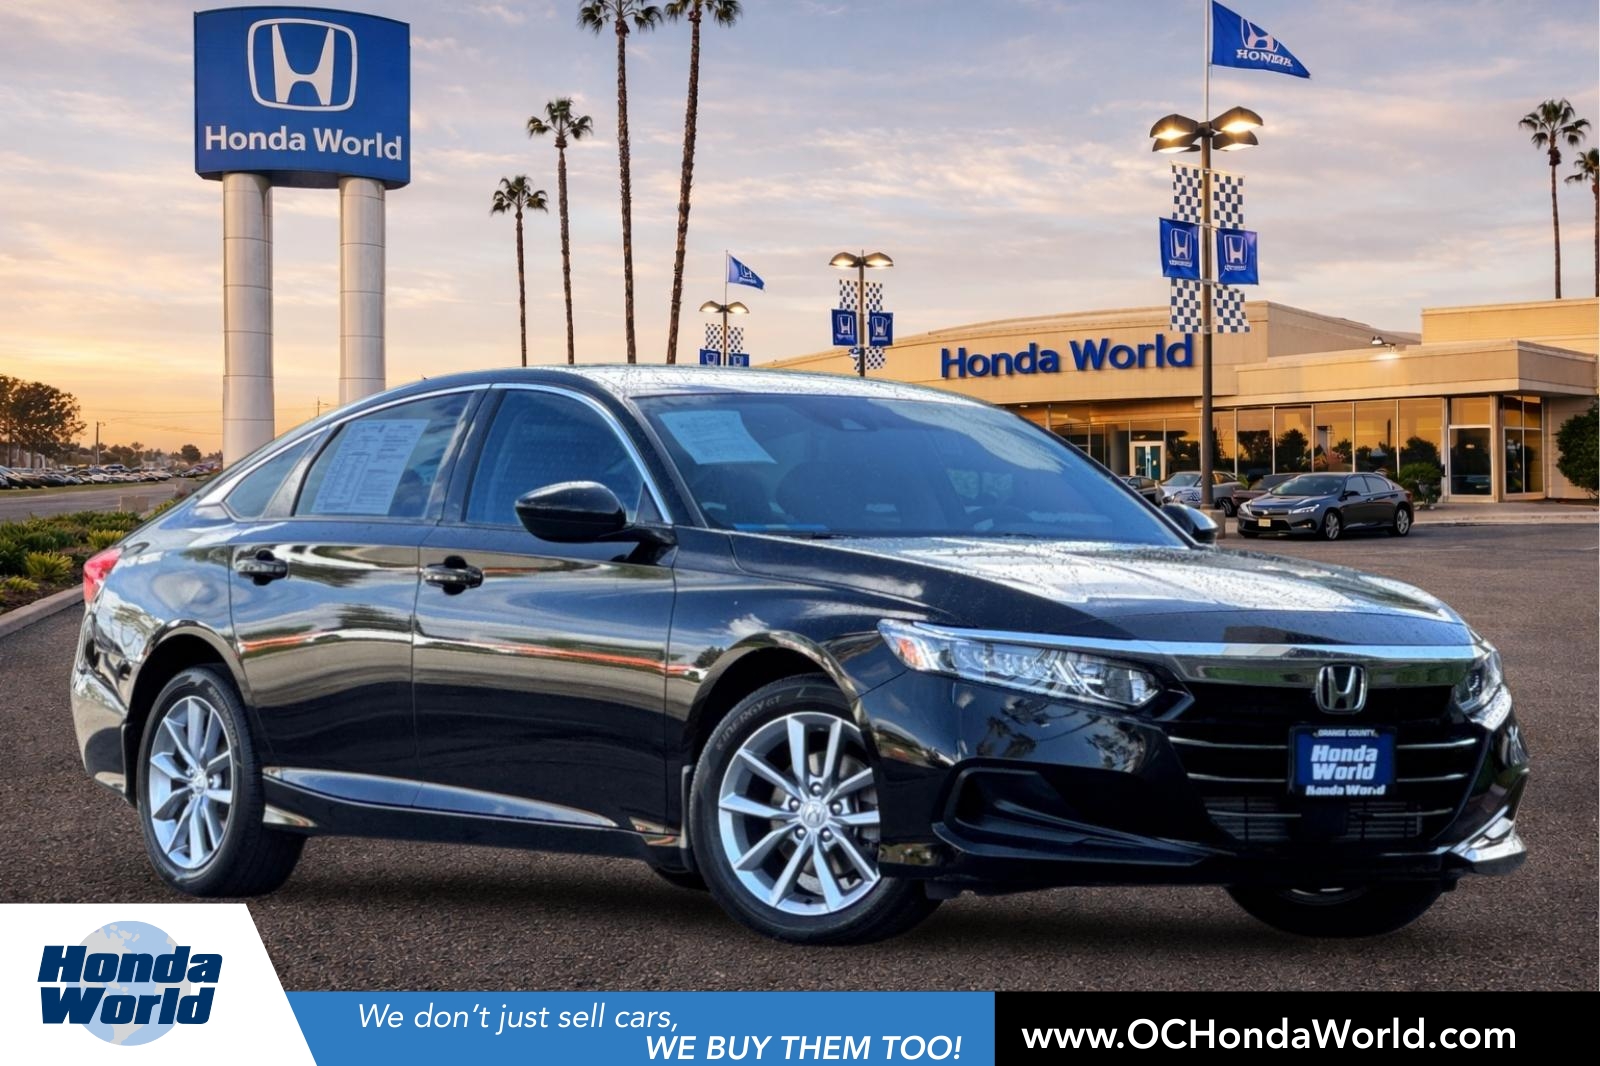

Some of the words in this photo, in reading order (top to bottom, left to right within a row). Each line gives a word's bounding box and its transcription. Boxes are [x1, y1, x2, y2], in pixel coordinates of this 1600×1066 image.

[205, 125, 306, 151] Honda
[313, 127, 402, 161] World
[941, 342, 1059, 378] Honda
[1069, 333, 1195, 371] World
[1317, 728, 1347, 738] ORANGE
[1347, 728, 1375, 738] COUNTY
[1311, 744, 1379, 762] Honda
[1312, 762, 1377, 781] World
[1305, 784, 1345, 796] Honda
